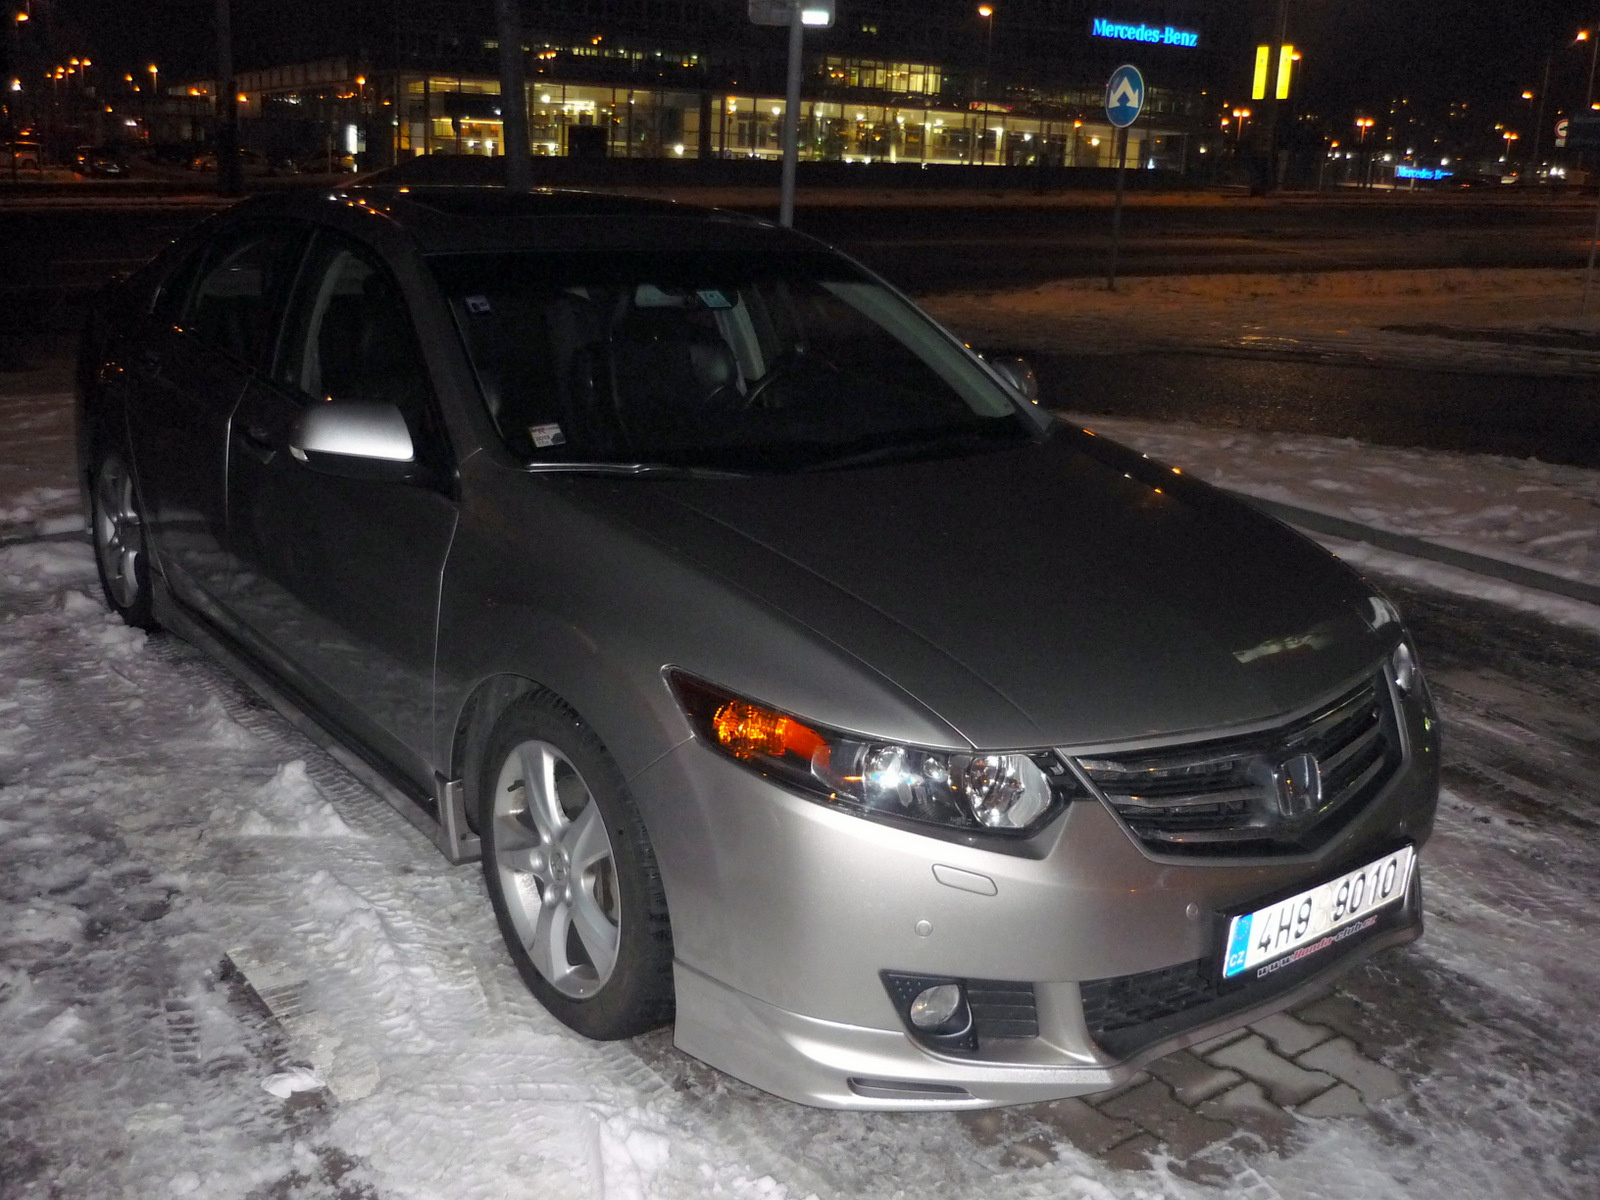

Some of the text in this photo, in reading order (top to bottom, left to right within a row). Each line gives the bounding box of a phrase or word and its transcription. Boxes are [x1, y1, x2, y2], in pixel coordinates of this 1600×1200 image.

[1092, 18, 1198, 47] Mercedes-Benz
[1396, 165, 1453, 181] Mercedes-B
[1257, 857, 1398, 953] 4H9 9010
[1229, 951, 1246, 967] CZ
